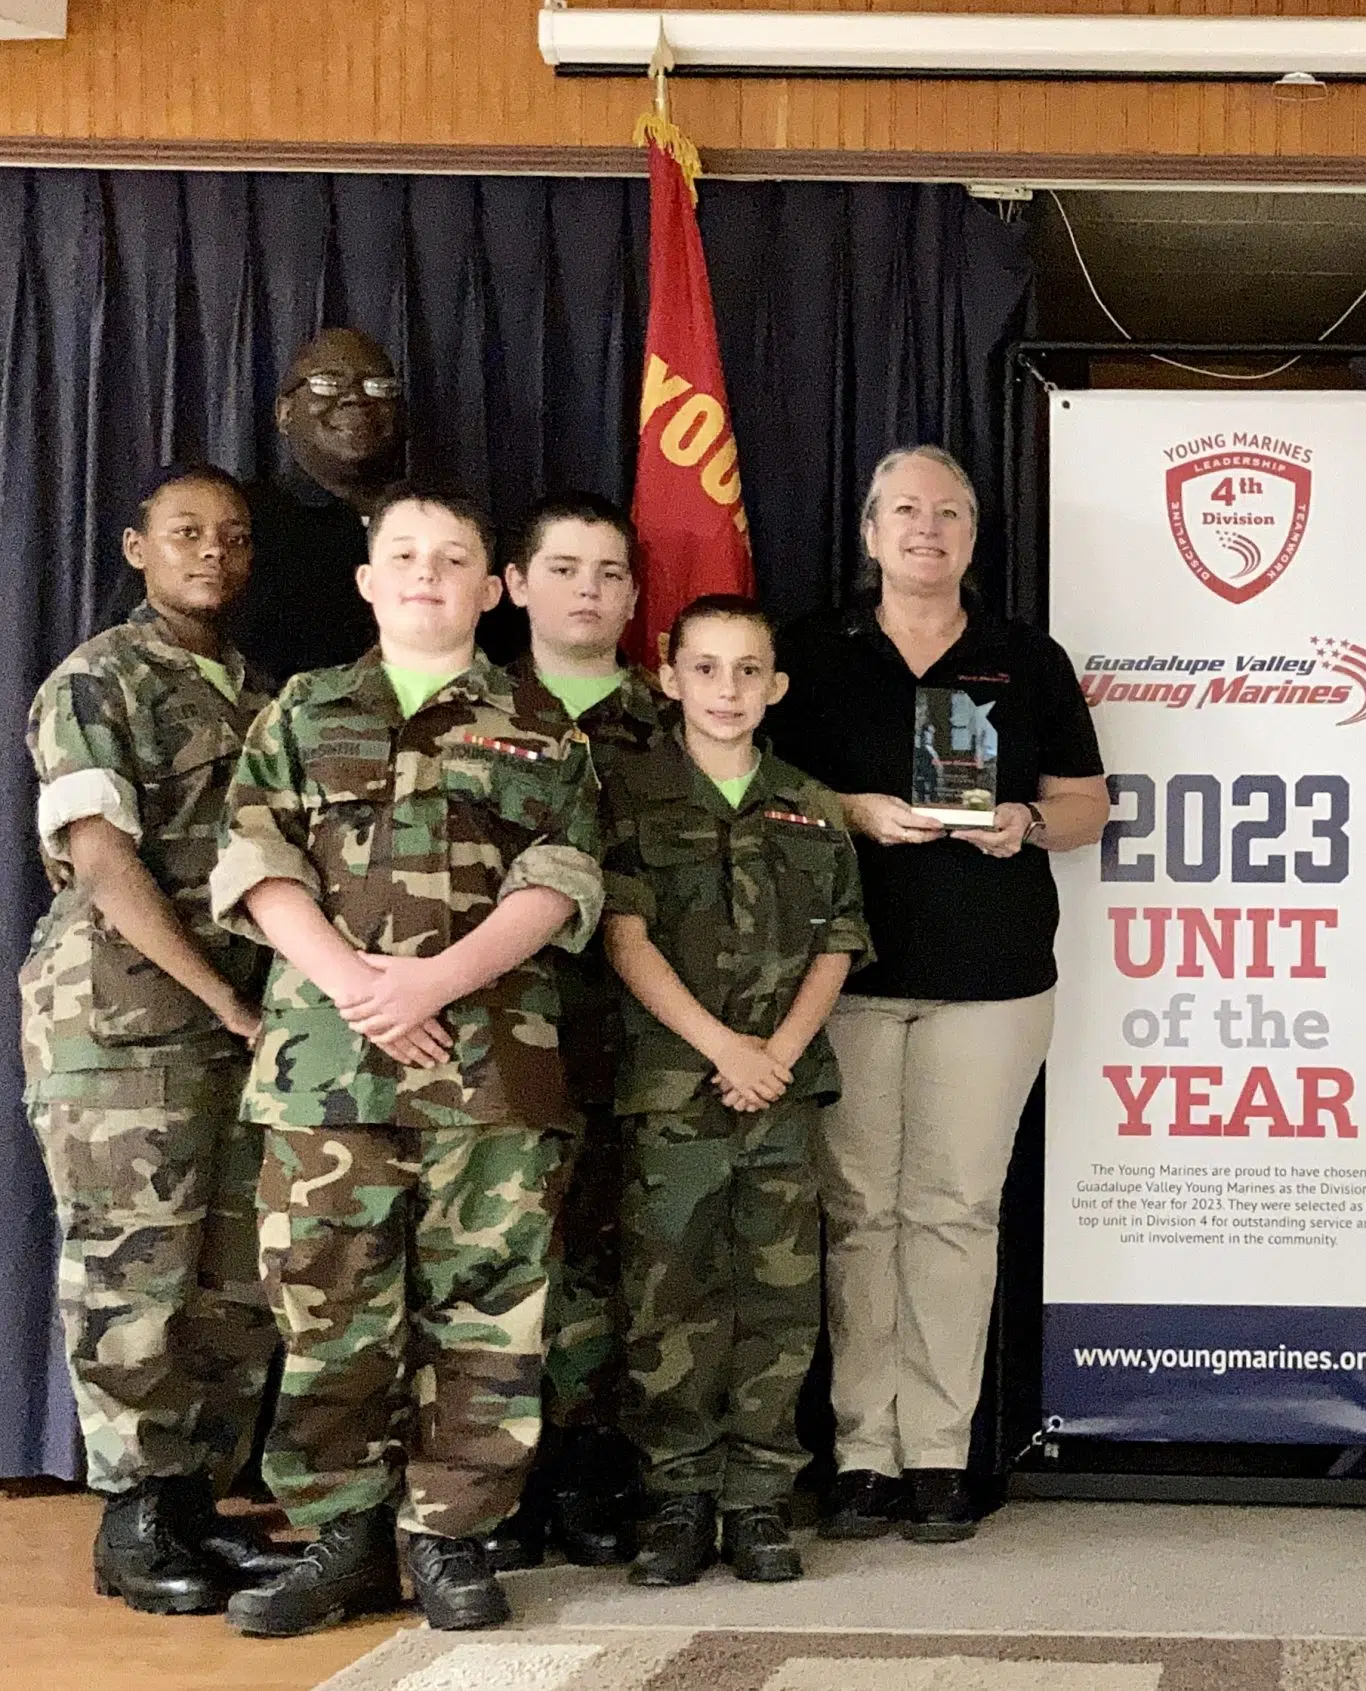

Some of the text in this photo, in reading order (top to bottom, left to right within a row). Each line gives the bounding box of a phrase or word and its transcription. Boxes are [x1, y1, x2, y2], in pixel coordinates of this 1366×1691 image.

[640, 352, 747, 533] YOU
[1164, 432, 1313, 463] YOUNG MARINES
[1194, 456, 1286, 472] LEADERSHIP
[1211, 477, 1263, 506] 4th
[1202, 512, 1275, 525] Division
[1171, 501, 1210, 581] DISCIPLINE
[1267, 504, 1306, 580] TEAMWORK
[1085, 655, 1316, 675] Guadalupe Valley
[1081, 674, 1353, 709] Young Marines
[1101, 774, 1349, 883] 2023
[1108, 907, 1338, 979] UNIT
[1122, 993, 1329, 1049] of the
[1102, 1065, 1358, 1138] YEAR
[1091, 1164, 1366, 1178] The Young Marines are proud to have chosen
[1077, 1181, 1142, 1194] Guadalupe
[1146, 1182, 1182, 1195] Valley
[1185, 1182, 1222, 1195] Young
[1227, 1183, 1275, 1194] Marines
[1279, 1185, 1292, 1194] as
[1296, 1183, 1316, 1194] the
[1071, 1197, 1096, 1209] Unit
[1101, 1198, 1113, 1209] of
[1117, 1198, 1137, 1209] the
[1141, 1198, 1166, 1209] Year
[1170, 1198, 1187, 1210] for
[1228, 1199, 1258, 1213] They
[1261, 1202, 1291, 1211] were
[1295, 1200, 1345, 1212] selected
[1350, 1203, 1363, 1212] as
[1079, 1216, 1099, 1228] top
[1103, 1215, 1127, 1226] unit
[1131, 1215, 1143, 1226] in
[1146, 1215, 1196, 1226] Division
[1200, 1216, 1207, 1226] 4
[1212, 1215, 1229, 1227] for
[1232, 1217, 1306, 1231] outstanding
[1310, 1218, 1352, 1229] service
[1120, 1232, 1144, 1243] unit
[1228, 1233, 1240, 1244] in
[1244, 1233, 1264, 1244] the
